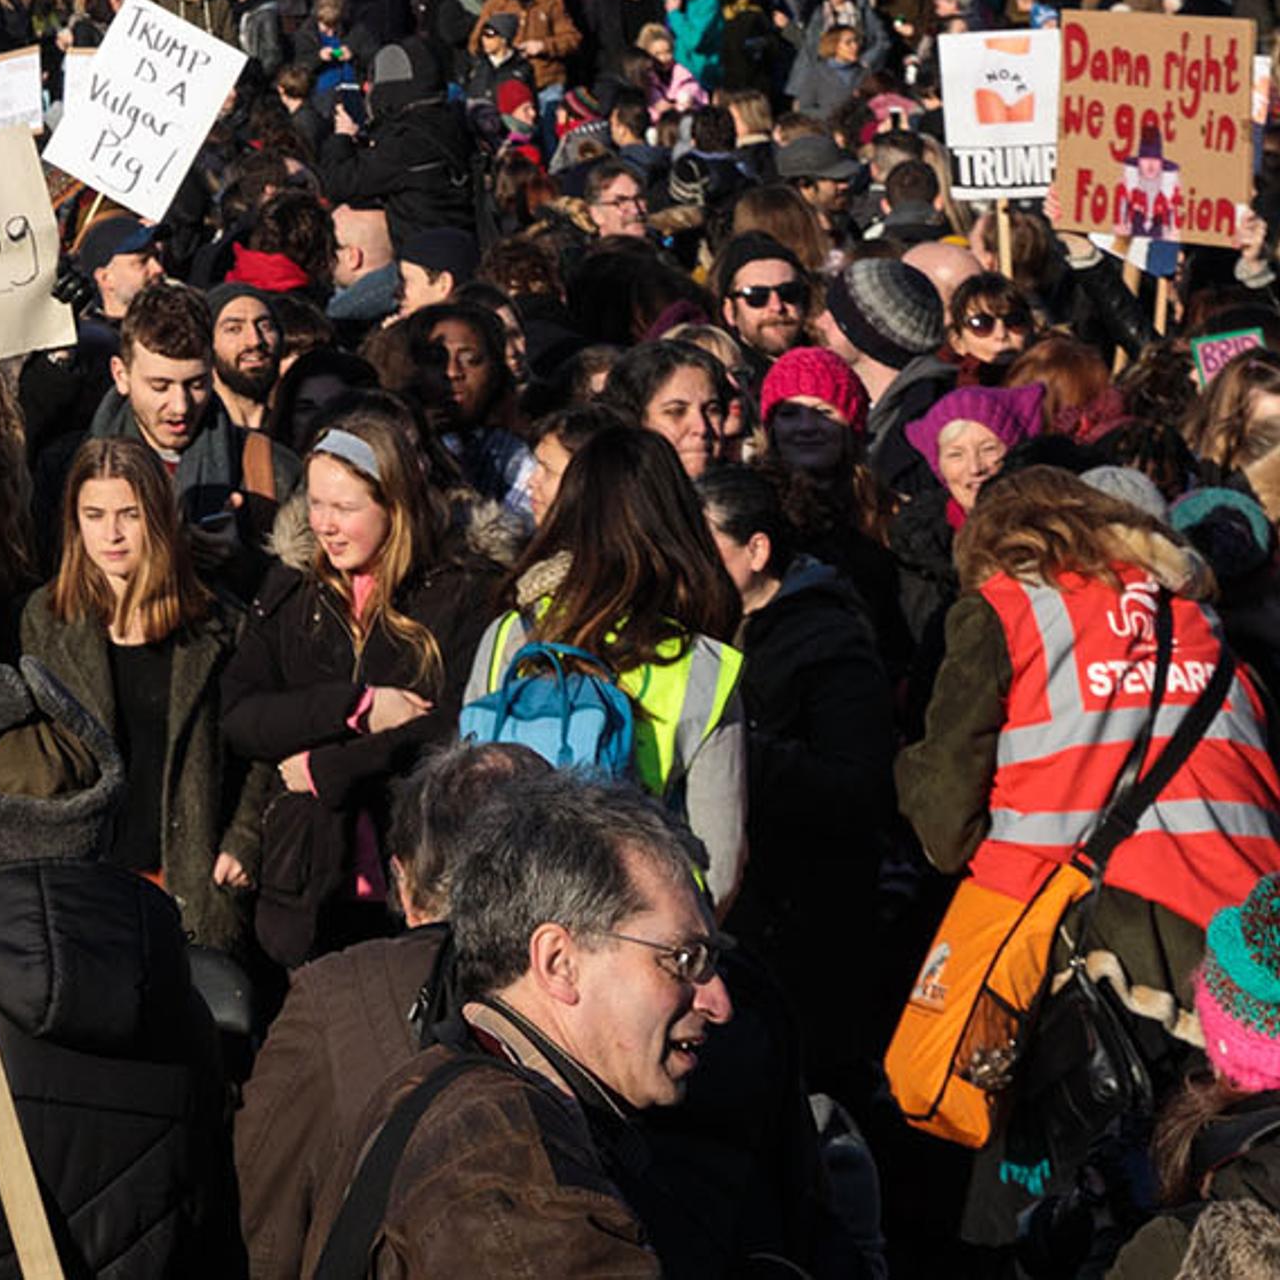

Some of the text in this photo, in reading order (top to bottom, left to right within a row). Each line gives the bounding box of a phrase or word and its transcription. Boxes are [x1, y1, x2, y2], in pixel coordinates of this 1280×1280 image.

[127, 4, 212, 74] TRUMP
[1063, 22, 1241, 120] Damn right
[89, 73, 172, 139] Vulgar
[165, 80, 188, 107] A
[1108, 100, 1177, 164] got
[953, 146, 1058, 188] TRUMP
[1073, 167, 1238, 237] Formation
[1086, 659, 1217, 697] STEWAR
